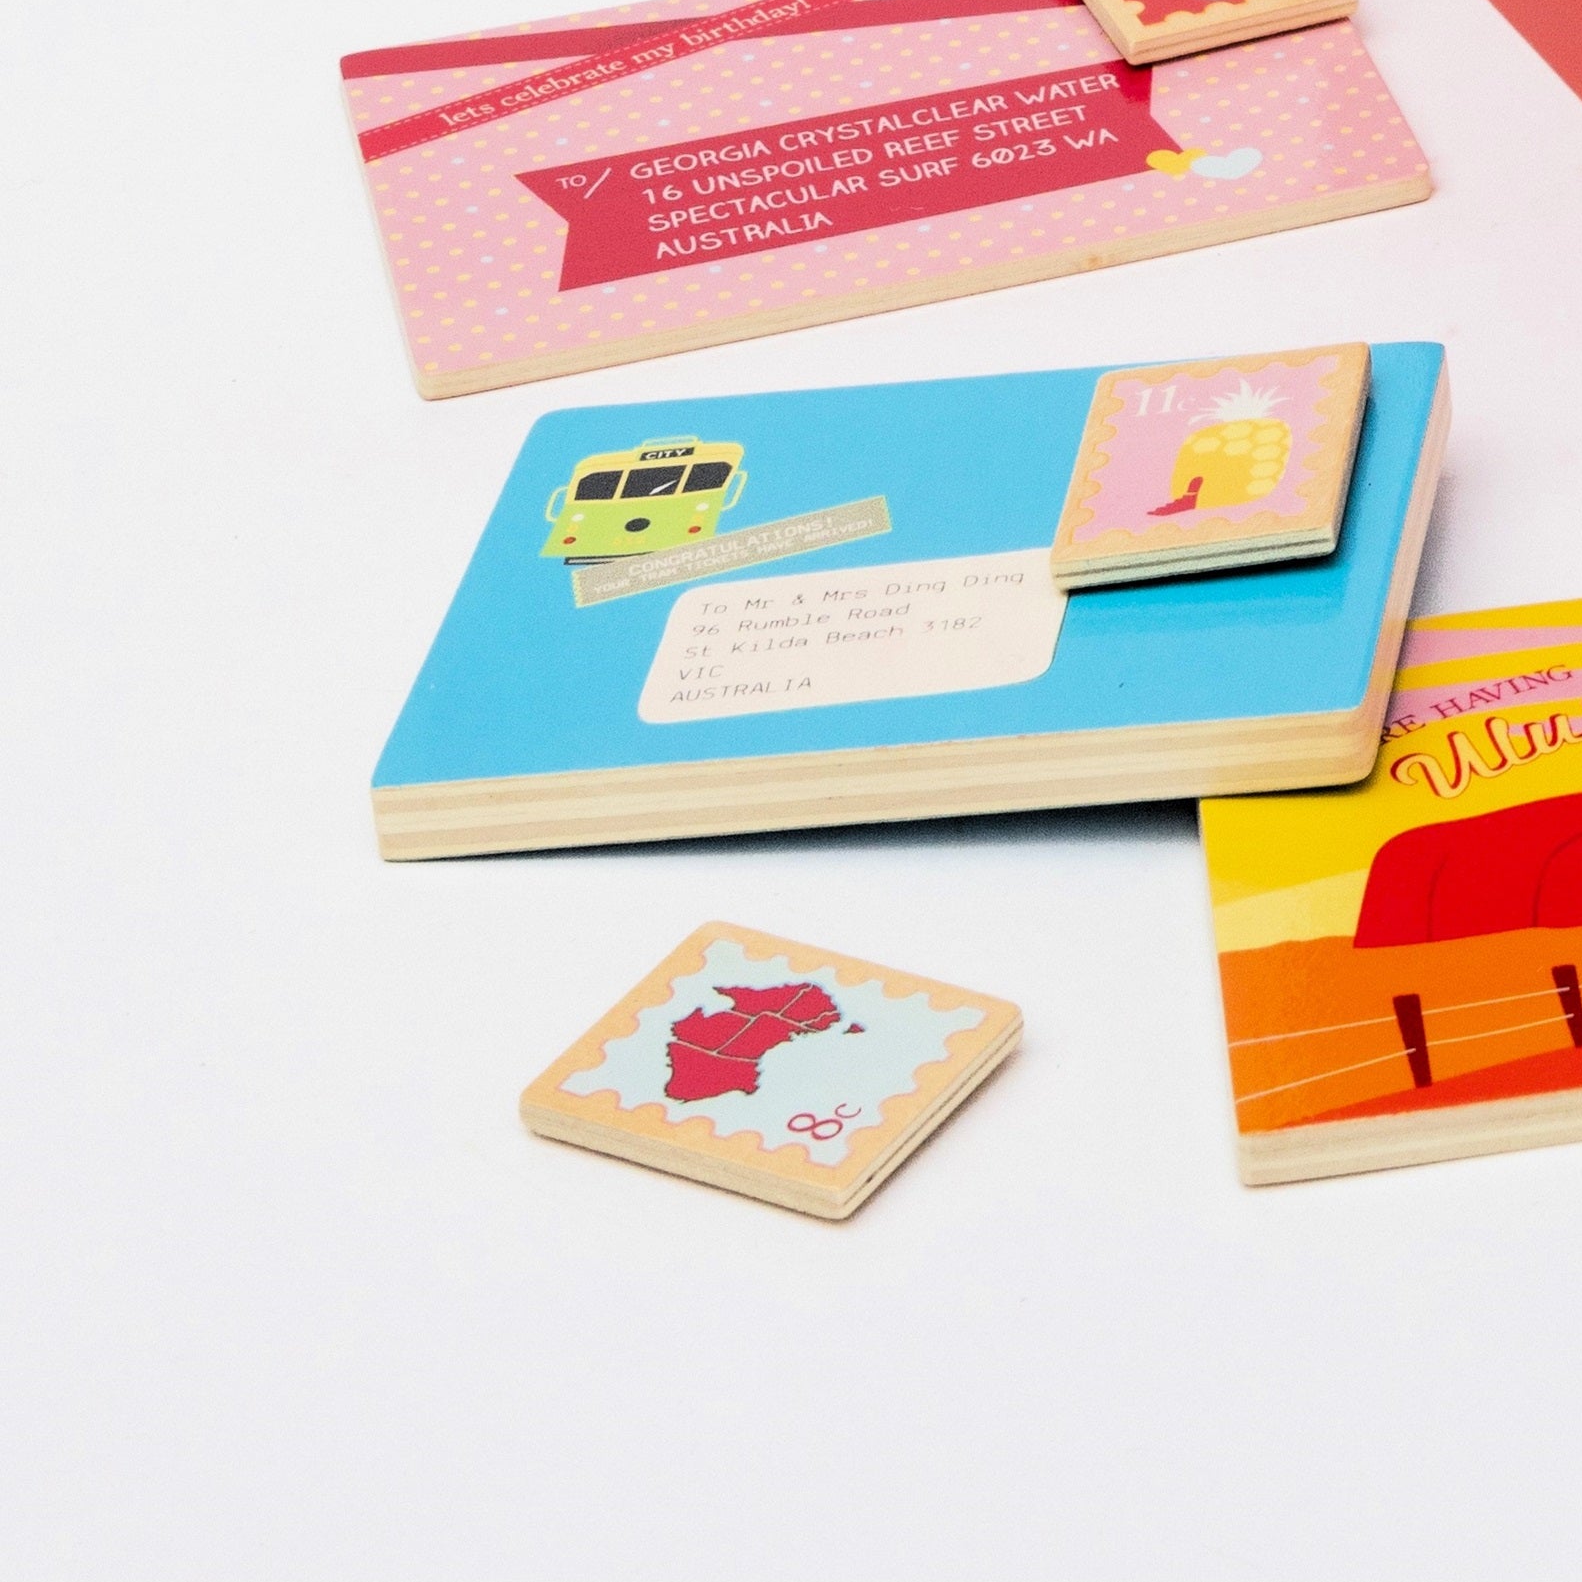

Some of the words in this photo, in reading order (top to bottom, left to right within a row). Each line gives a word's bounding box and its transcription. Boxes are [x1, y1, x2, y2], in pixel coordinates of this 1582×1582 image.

[439, 100, 496, 127] lets
[500, 58, 624, 109] celebrate
[631, 43, 674, 68] my
[629, 137, 772, 183] GEORGIA
[779, 97, 1007, 153] CRYSTALCLEAR
[1014, 72, 1121, 106] WATER
[642, 183, 683, 206] 16
[692, 148, 872, 198] UNSPOILED
[884, 128, 961, 158] REEF
[973, 104, 1089, 142] STREET
[647, 176, 869, 233] SPECTACULAR
[878, 156, 959, 189] SURF
[972, 136, 1058, 171] 6023
[1070, 127, 1119, 151] WA
[654, 211, 833, 261] AUSTRALIA
[1134, 385, 1196, 417] 11c
[645, 448, 686, 460] CITY
[628, 517, 833, 578] CONGRATULATIONS!
[701, 603, 728, 615] To
[746, 598, 775, 611] Mr
[792, 594, 804, 605] &
[823, 590, 868, 602] Mrs
[885, 581, 946, 595] Ding
[963, 571, 1024, 587] Ding
[685, 645, 713, 659] St
[732, 636, 809, 655] Kilda
[826, 626, 904, 645] Beach
[923, 616, 981, 633] 3182
[692, 624, 720, 636] 96
[739, 612, 830, 631] Rumble
[848, 603, 910, 620] Road
[670, 677, 811, 703] AUSTRALIA
[679, 665, 724, 680] VIC
[1430, 664, 1573, 721] HAVING
